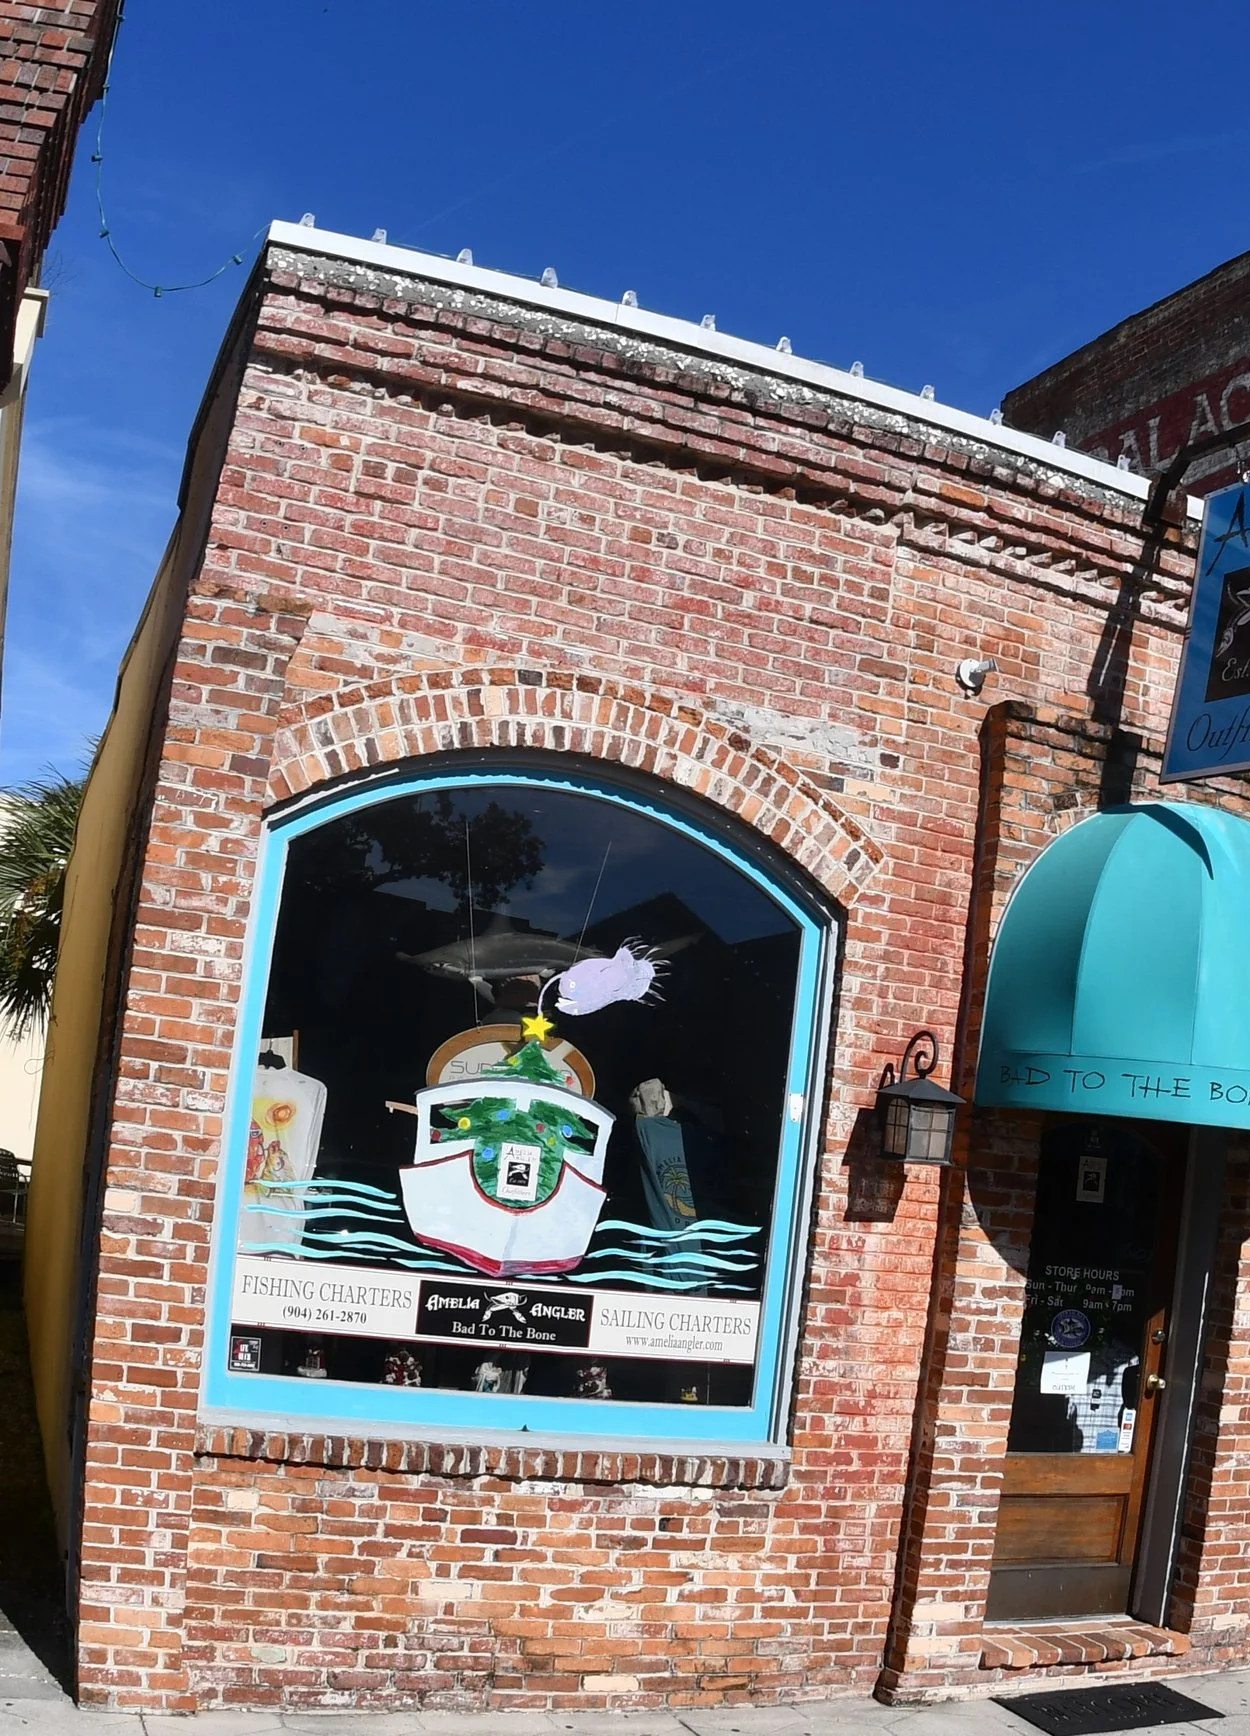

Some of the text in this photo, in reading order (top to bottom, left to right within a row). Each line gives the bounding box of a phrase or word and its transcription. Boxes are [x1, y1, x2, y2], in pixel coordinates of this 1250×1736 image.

[1221, 658, 1249, 681] Est.
[999, 1065, 1051, 1087] BAD
[1063, 1069, 1105, 1093] TO
[1121, 1073, 1191, 1098] THE
[1045, 1265, 1120, 1281] STORE HOURS
[241, 1274, 412, 1309] FISHING CHARTERS
[1025, 1279, 1045, 1290] Sun
[1055, 1281, 1078, 1293] Thur
[529, 1302, 586, 1322] ANGLER
[1047, 1295, 1064, 1307] Sat
[1083, 1299, 1103, 1309] 9am
[1112, 1301, 1133, 1312] 7pm
[282, 1305, 367, 1324] (904) 261-2870
[600, 1308, 752, 1335] SAILING CHARTERS
[452, 1321, 557, 1341] Bad To The Bone
[625, 1334, 723, 1353] www.ameliaangler.com
